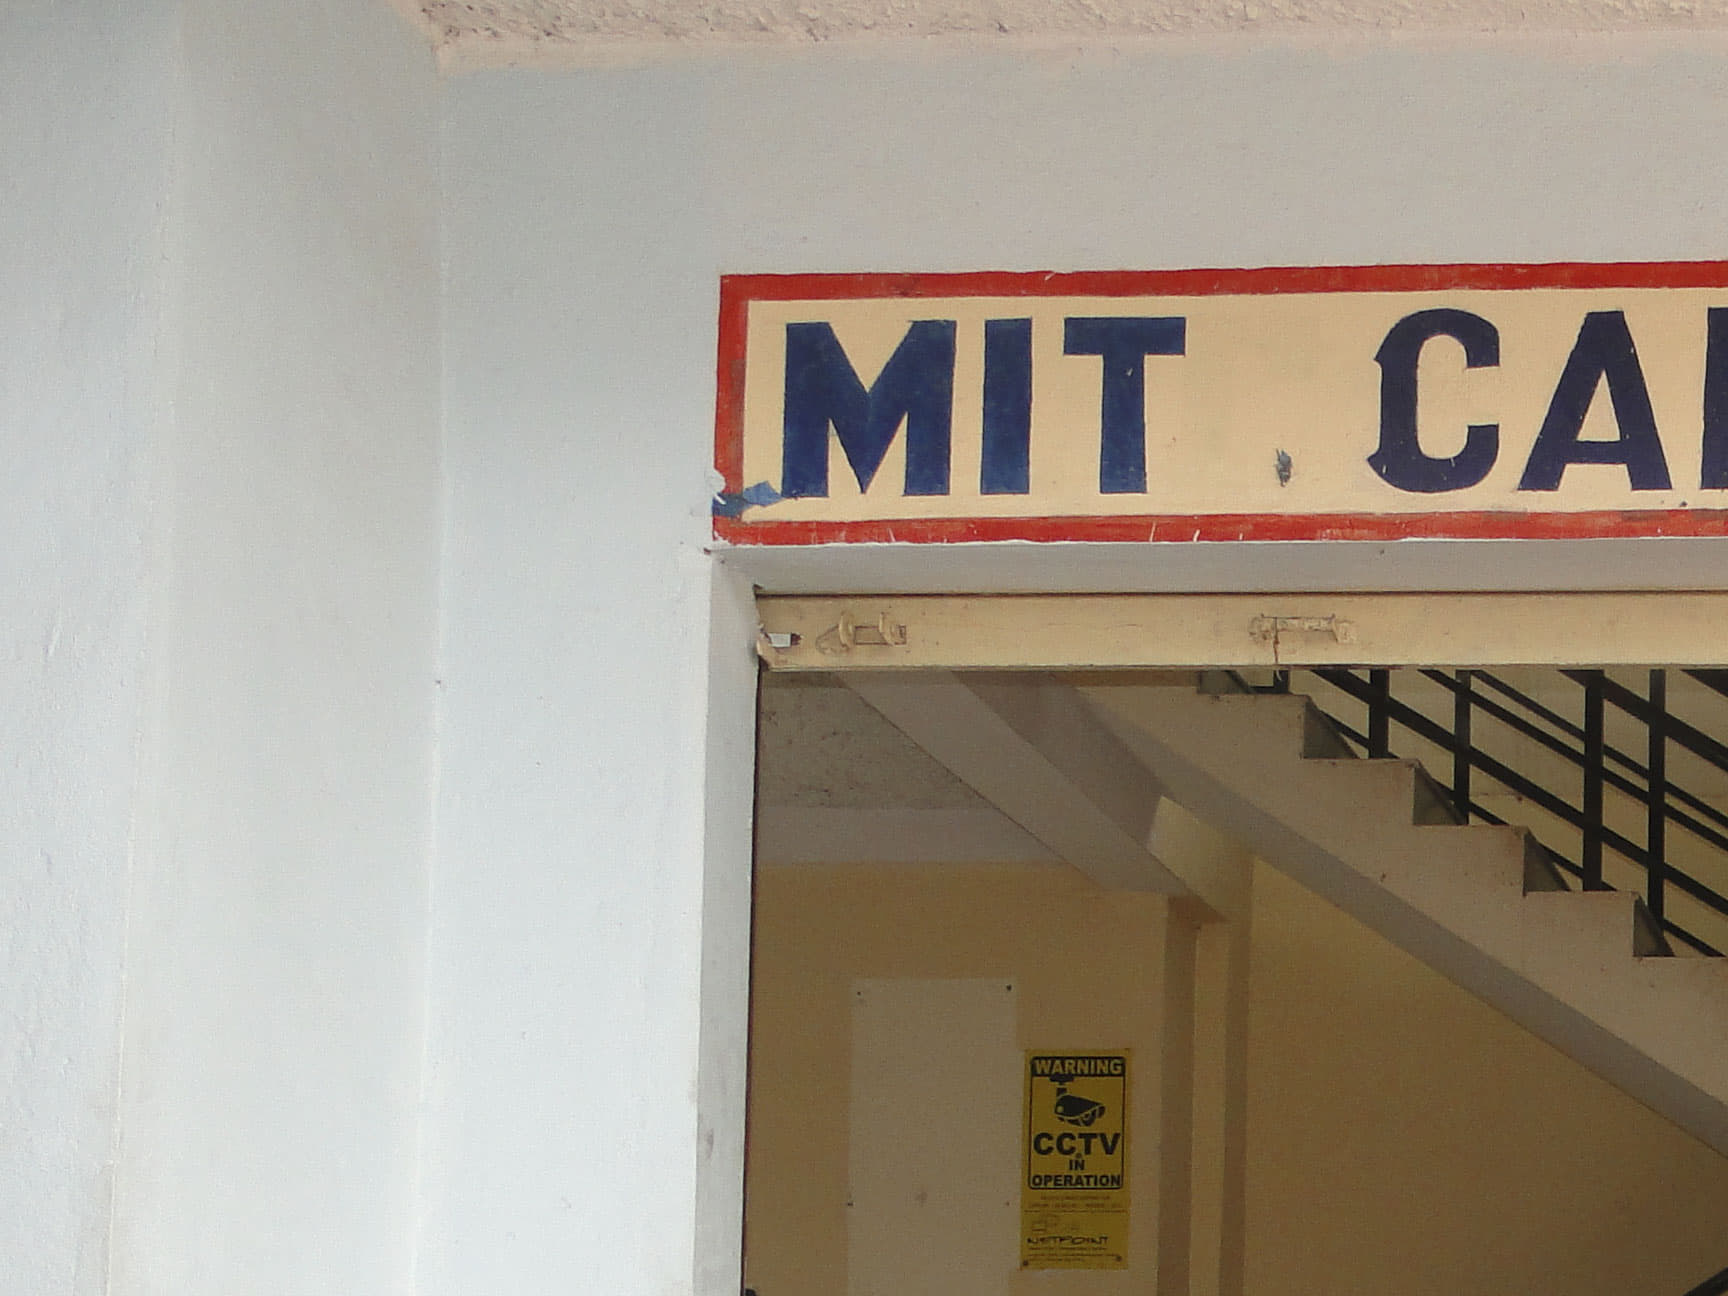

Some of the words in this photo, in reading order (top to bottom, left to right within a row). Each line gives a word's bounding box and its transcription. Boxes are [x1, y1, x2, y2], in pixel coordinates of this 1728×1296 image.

[782, 316, 1187, 498] MIT
[1034, 1058, 1123, 1075] WARNING
[1033, 1132, 1121, 1156] CCTV
[1068, 1160, 1085, 1171] IN
[1031, 1174, 1121, 1187] OPERATION
